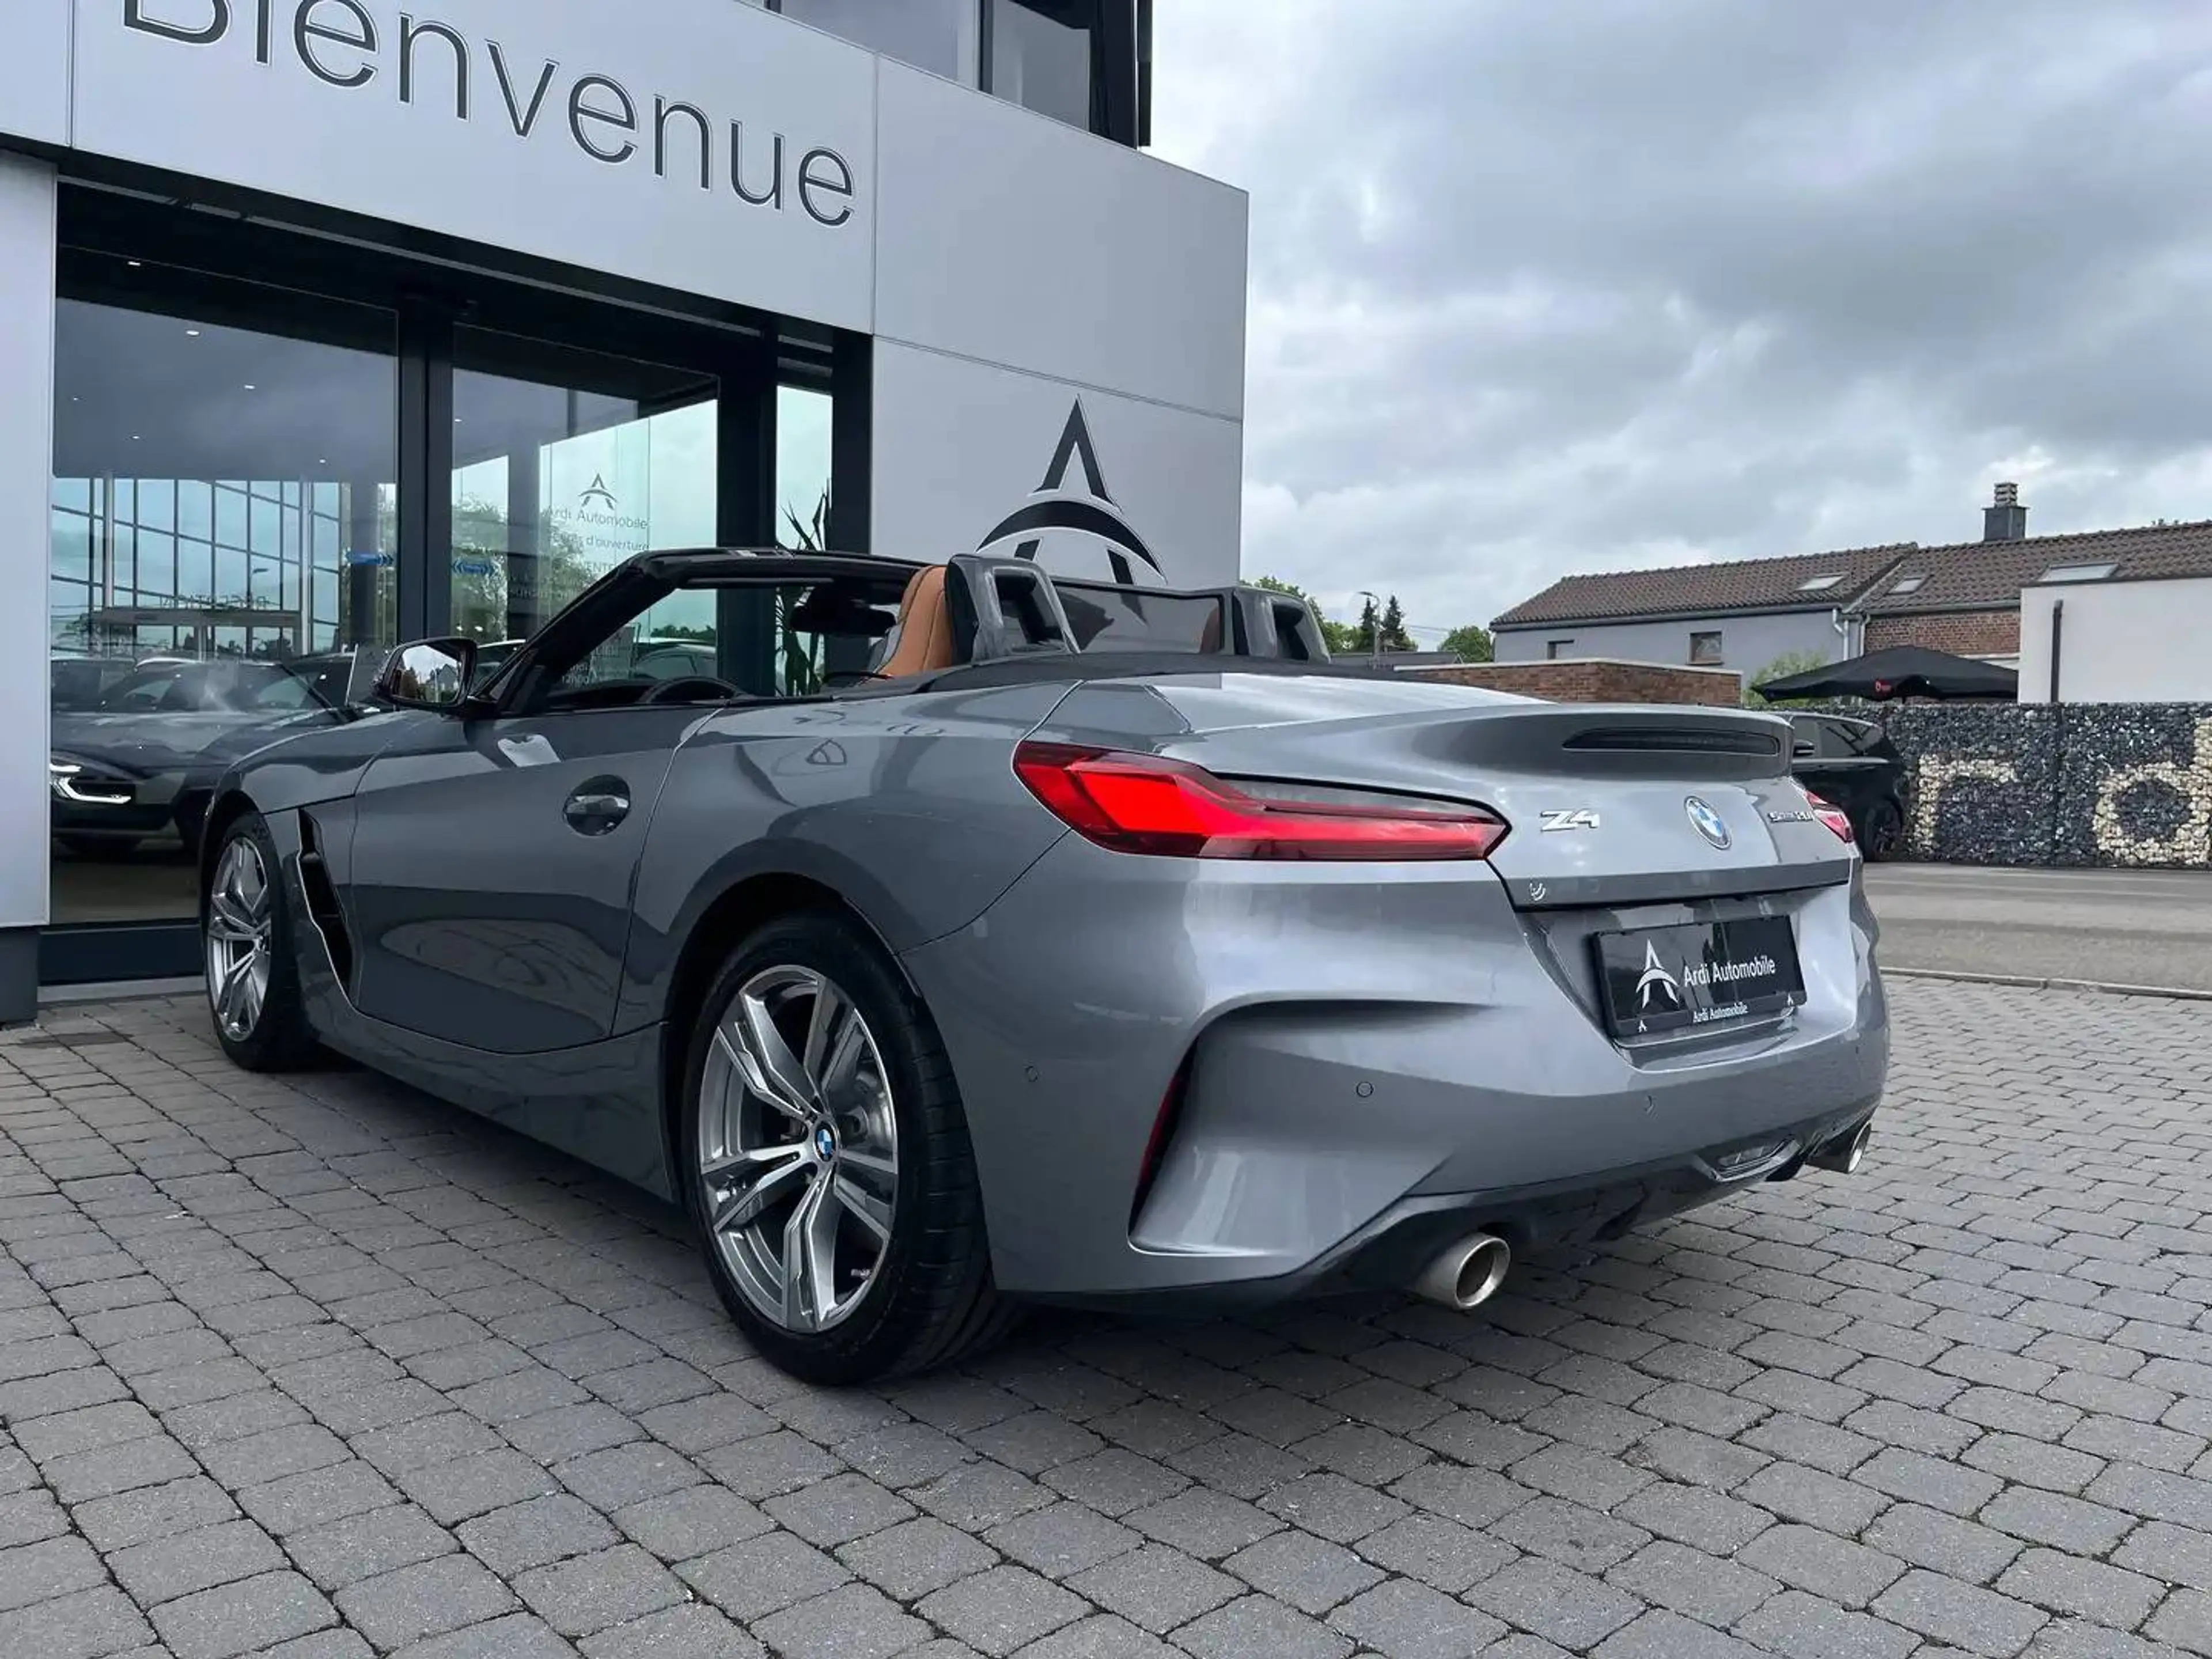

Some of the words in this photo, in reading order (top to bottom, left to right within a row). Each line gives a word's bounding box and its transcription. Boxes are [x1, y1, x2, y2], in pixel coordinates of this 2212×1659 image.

[577, 509, 649, 530] Automobile
[1540, 808, 1600, 832] Z4
[1684, 963, 1711, 988] Ardi
[1713, 955, 1777, 983] Automobile
[1692, 1007, 1709, 1023] Ardi
[1710, 1001, 1749, 1020] Automobile
